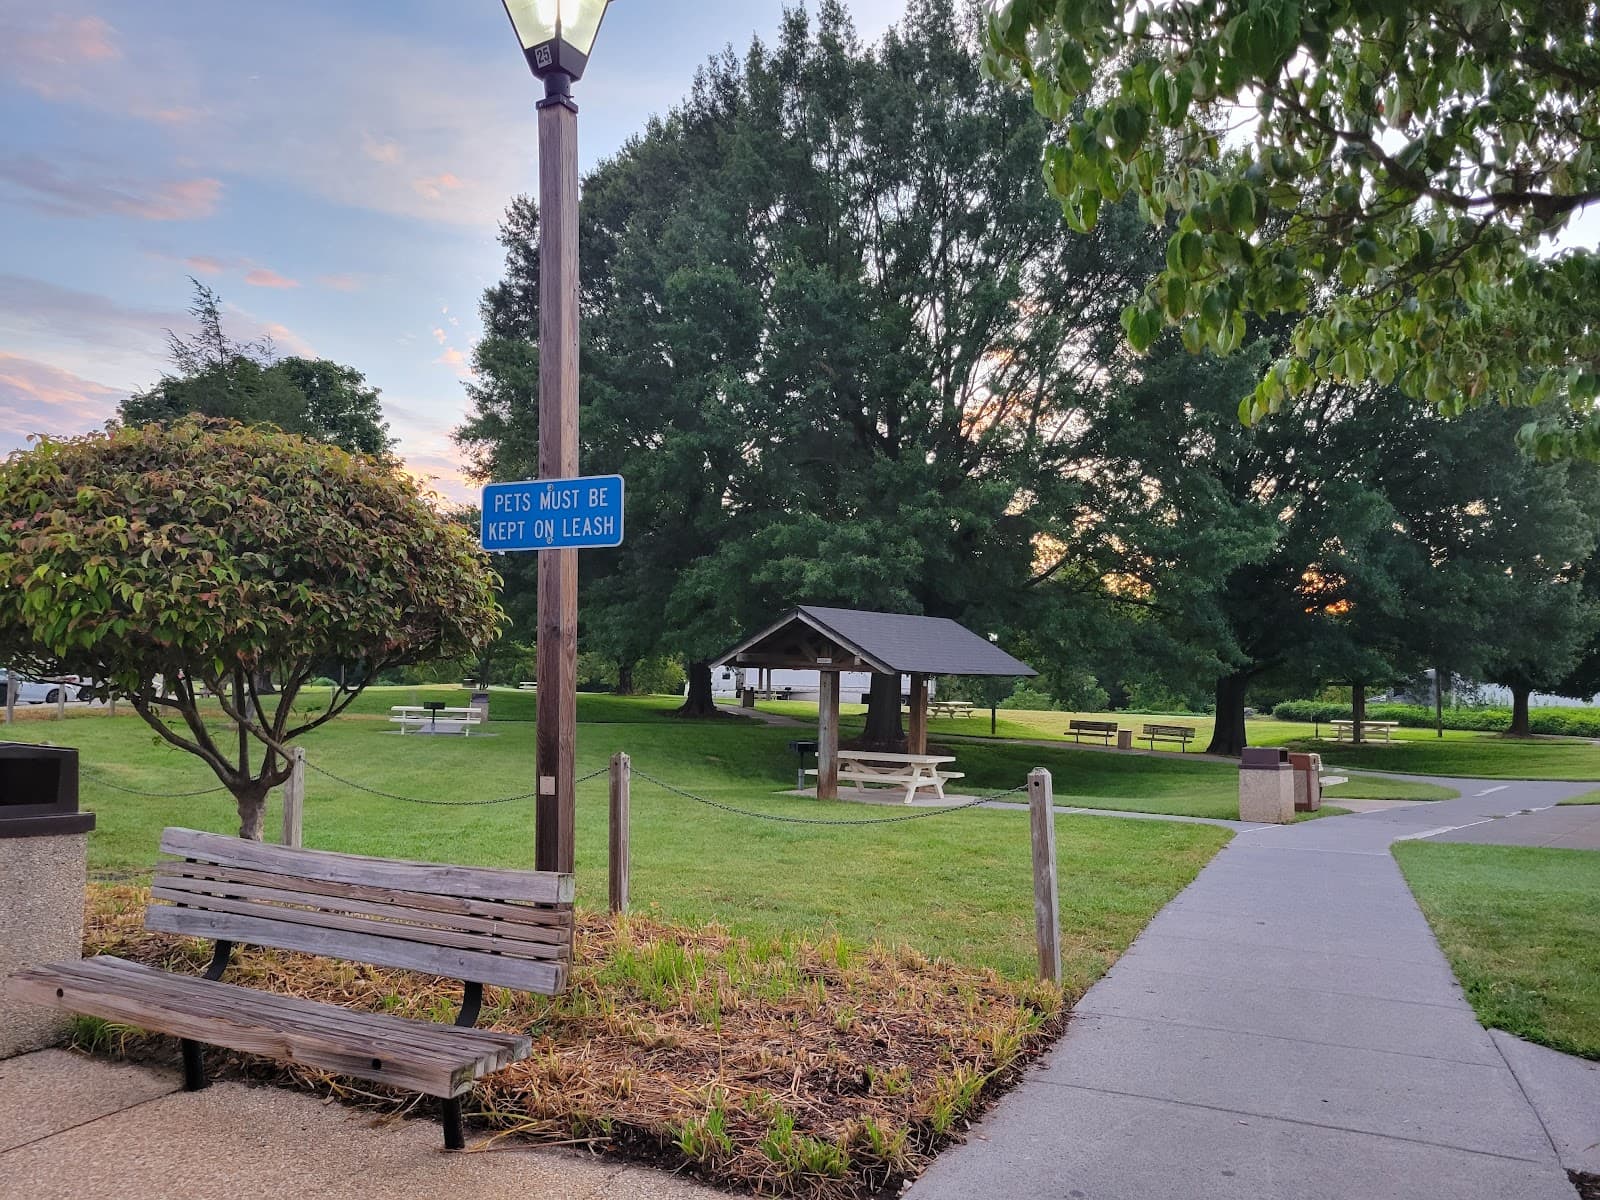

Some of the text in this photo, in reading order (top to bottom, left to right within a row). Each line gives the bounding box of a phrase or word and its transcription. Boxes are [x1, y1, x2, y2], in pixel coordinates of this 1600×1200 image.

[536, 46, 550, 64] 25
[494, 487, 609, 513] PETS MUST BE
[488, 516, 614, 541] KEPT ON LEASH
